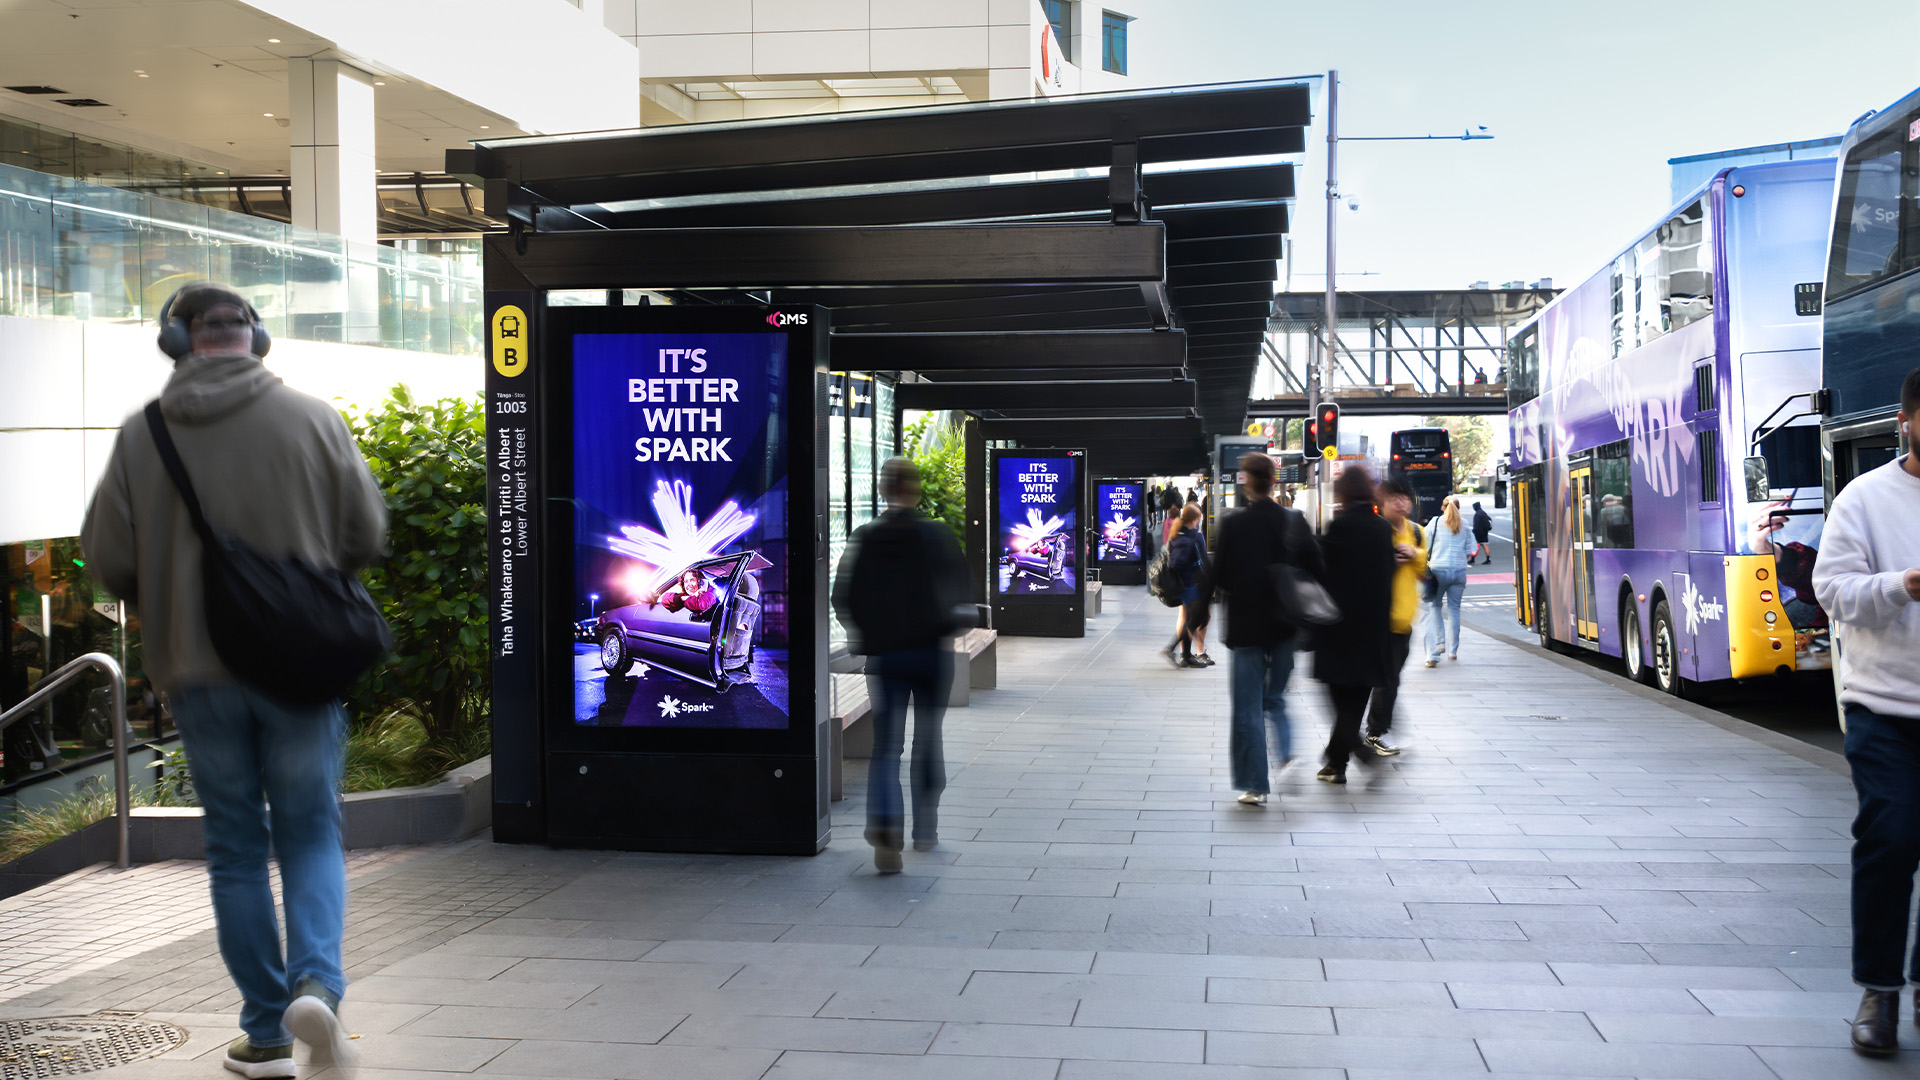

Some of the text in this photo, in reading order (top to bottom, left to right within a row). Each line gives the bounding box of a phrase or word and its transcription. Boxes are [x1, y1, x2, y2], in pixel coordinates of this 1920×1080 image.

[771, 311, 808, 328] QMS
[504, 348, 518, 367] B
[659, 348, 707, 373] IT'S
[628, 378, 739, 402] BETTER
[496, 401, 527, 414] 1003
[643, 408, 722, 432] WITH
[635, 437, 733, 462] SPARK
[1029, 463, 1047, 472] IT'S
[1018, 473, 1058, 483] BETTER
[514, 427, 528, 557] Lower Albert Street
[1023, 483, 1053, 492] WITH
[1020, 494, 1056, 503] SPARK
[499, 427, 514, 657] Taha Whakararo o te Tiriti o Albert
[103, 604, 116, 613] 04
